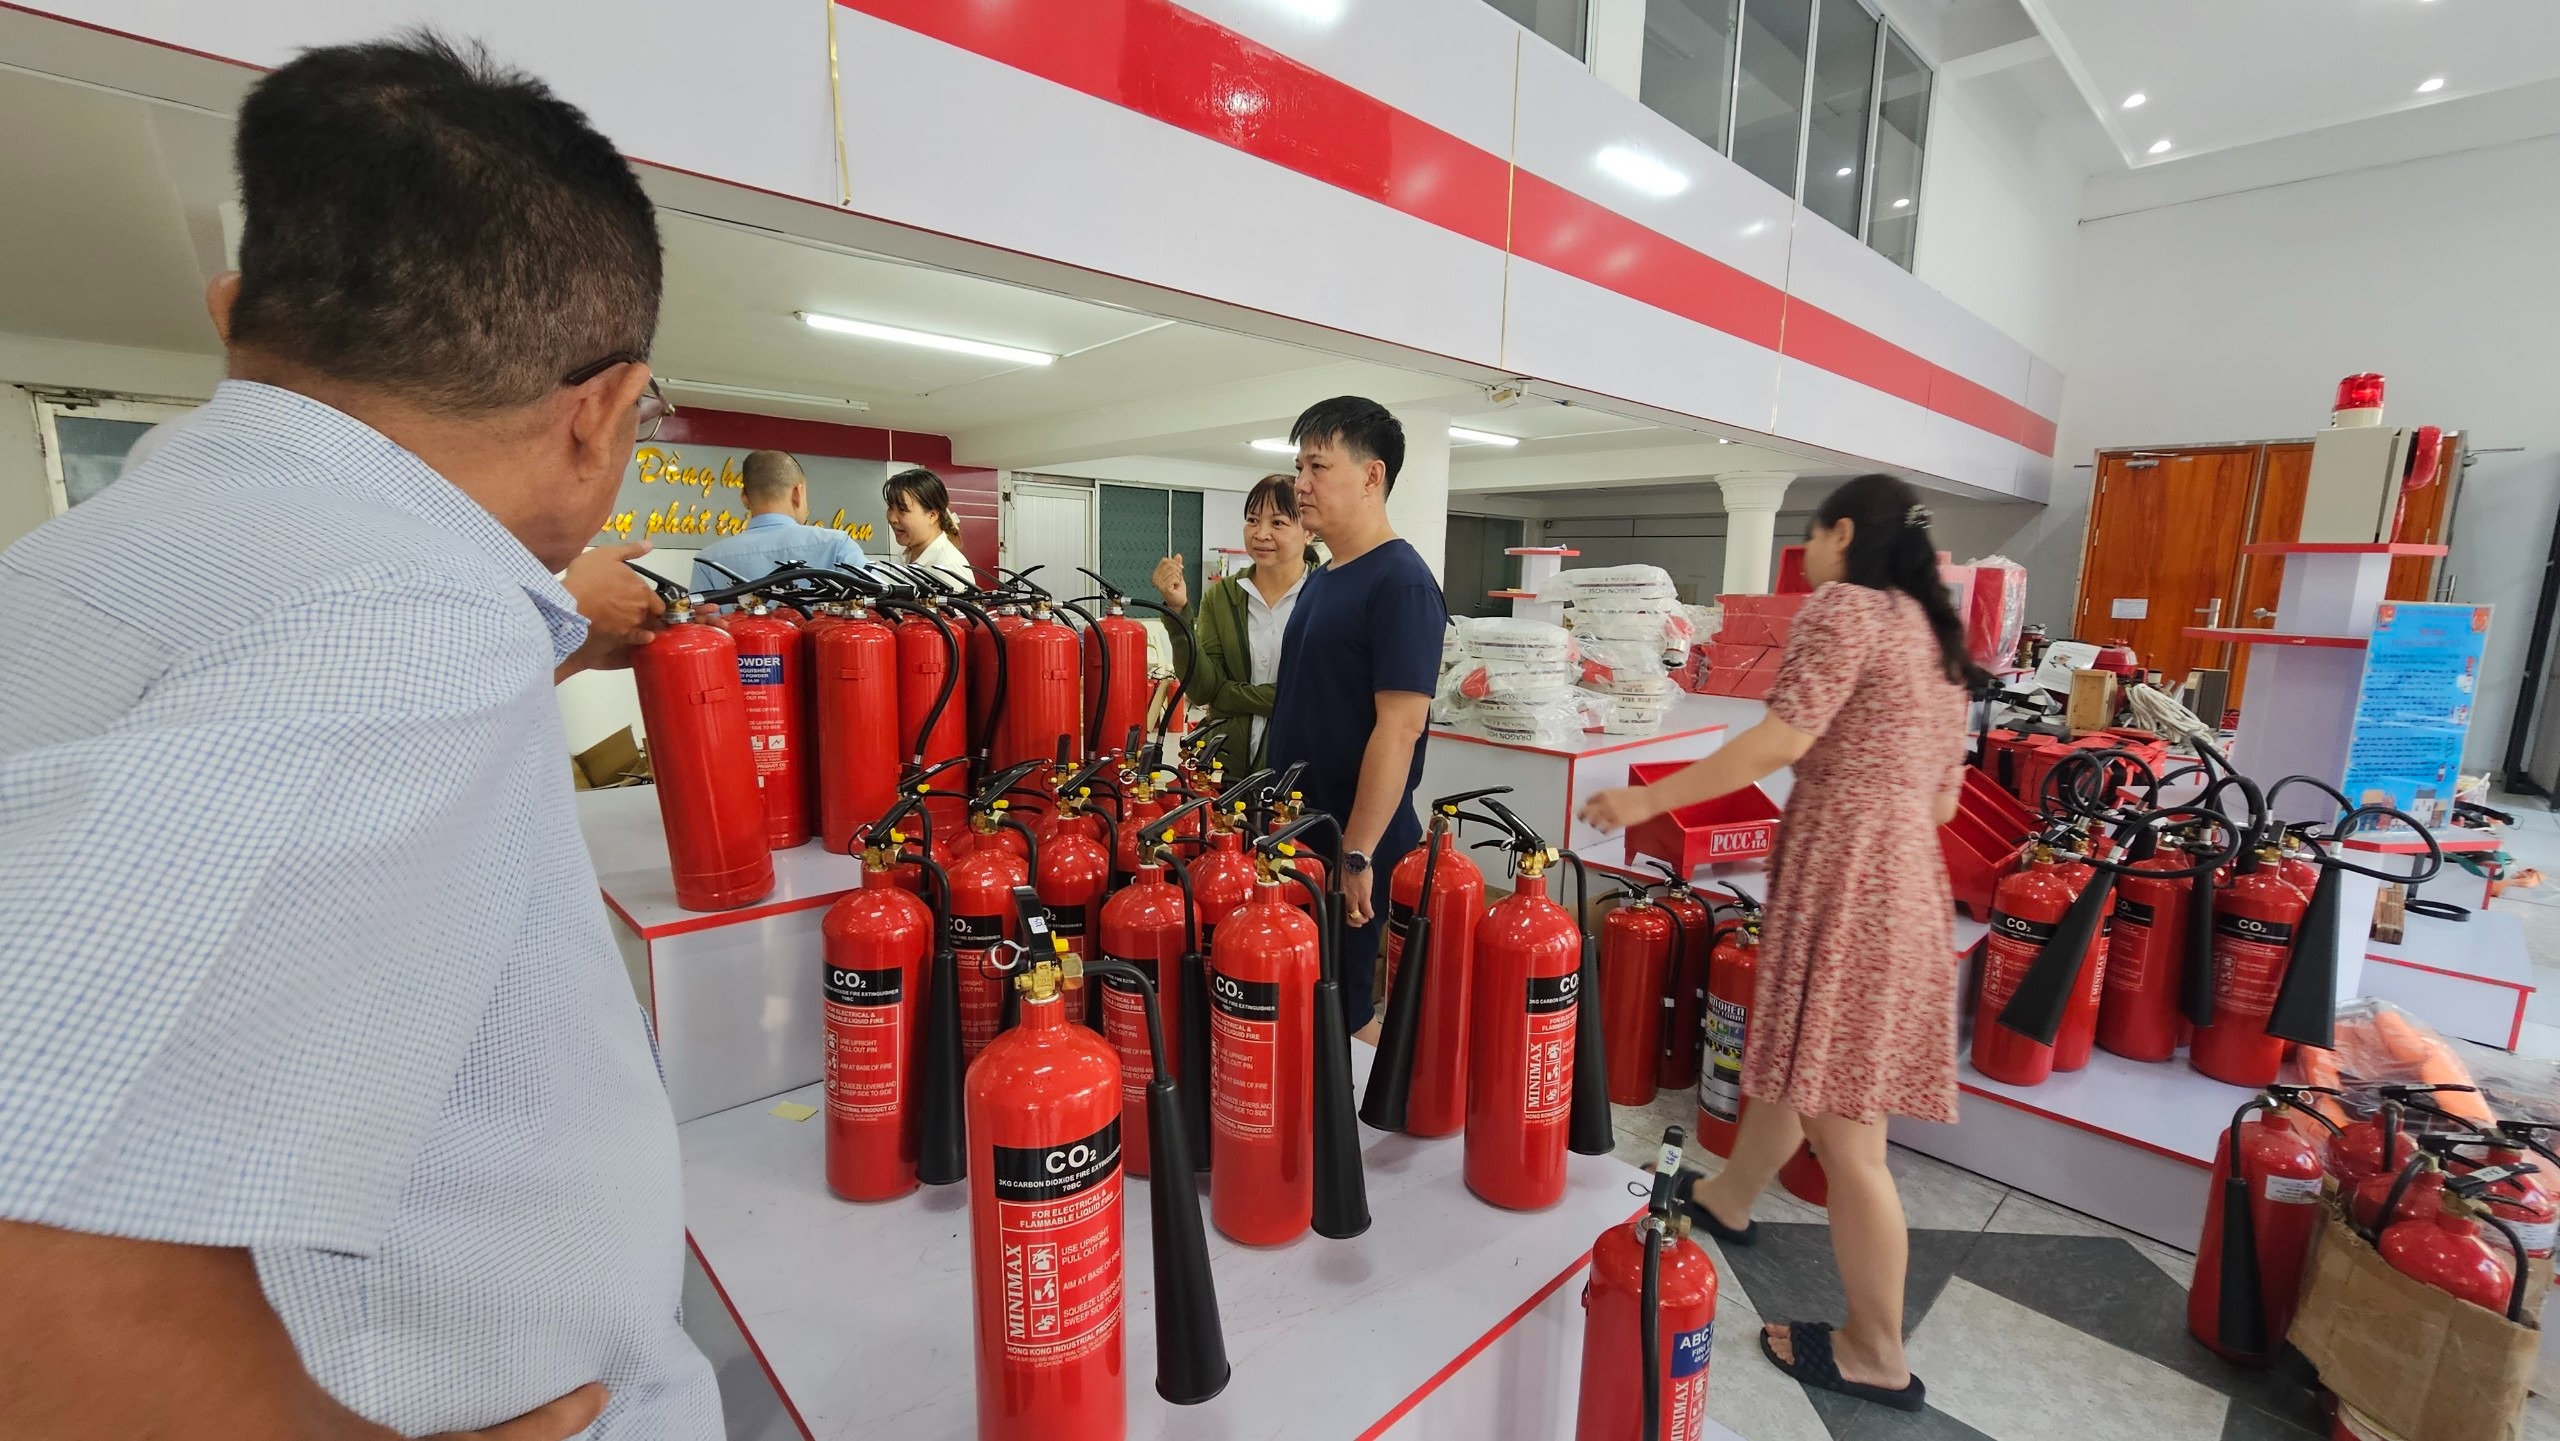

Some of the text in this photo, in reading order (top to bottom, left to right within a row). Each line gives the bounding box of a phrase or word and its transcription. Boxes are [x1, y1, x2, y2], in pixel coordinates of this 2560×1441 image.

[636, 448, 715, 498] Đồng
[644, 501, 711, 541] phát
[738, 658, 780, 666] OWDER
[1500, 732, 1532, 741] DRAGON
[1712, 832, 1752, 852] PCCC
[1043, 907, 1056, 920] O2
[2006, 917, 2032, 932] CO2
[2238, 919, 2267, 932] CO2
[834, 970, 866, 988] CO2
[1216, 976, 1244, 1000] CO2
[861, 988, 899, 996] EXTINGUISHER
[880, 1062, 892, 1070] FIRE
[1528, 1042, 1542, 1108] MINIMAX
[1013, 1180, 1044, 1188] CARBON
[1046, 1175, 1074, 1186] DIOXIDE
[1076, 1170, 1090, 1179] FIRE
[1091, 1143, 1121, 1172] EXTINGUISH
[1045, 1144, 1097, 1174] CO2
[1020, 1191, 1114, 1228] FLAMMABLE LIQUID FIRE
[1032, 1210, 1050, 1219] FOR
[1052, 1196, 1101, 1218] ELECTRICAL
[1061, 1226, 1109, 1255] USE UPRIGHT
[1062, 1236, 1110, 1265] PULL OUT PIN
[1063, 1281, 1077, 1291] AIM
[1078, 1276, 1087, 1286] AT
[1088, 1265, 1104, 1280] BASE
[1006, 1243, 1025, 1339] MINIMAX
[1064, 1298, 1096, 1318] SQUEEZE
[1064, 1312, 1089, 1328] SWEEP
[1090, 1302, 1105, 1316] SIDE
[1007, 1346, 1028, 1356] HONG
[1030, 1347, 1051, 1355] KONG
[1053, 1332, 1095, 1353] INDUSTRIAL
[1680, 1327, 1709, 1350] ABC
[1671, 1381, 1689, 1441] MINIMAX
